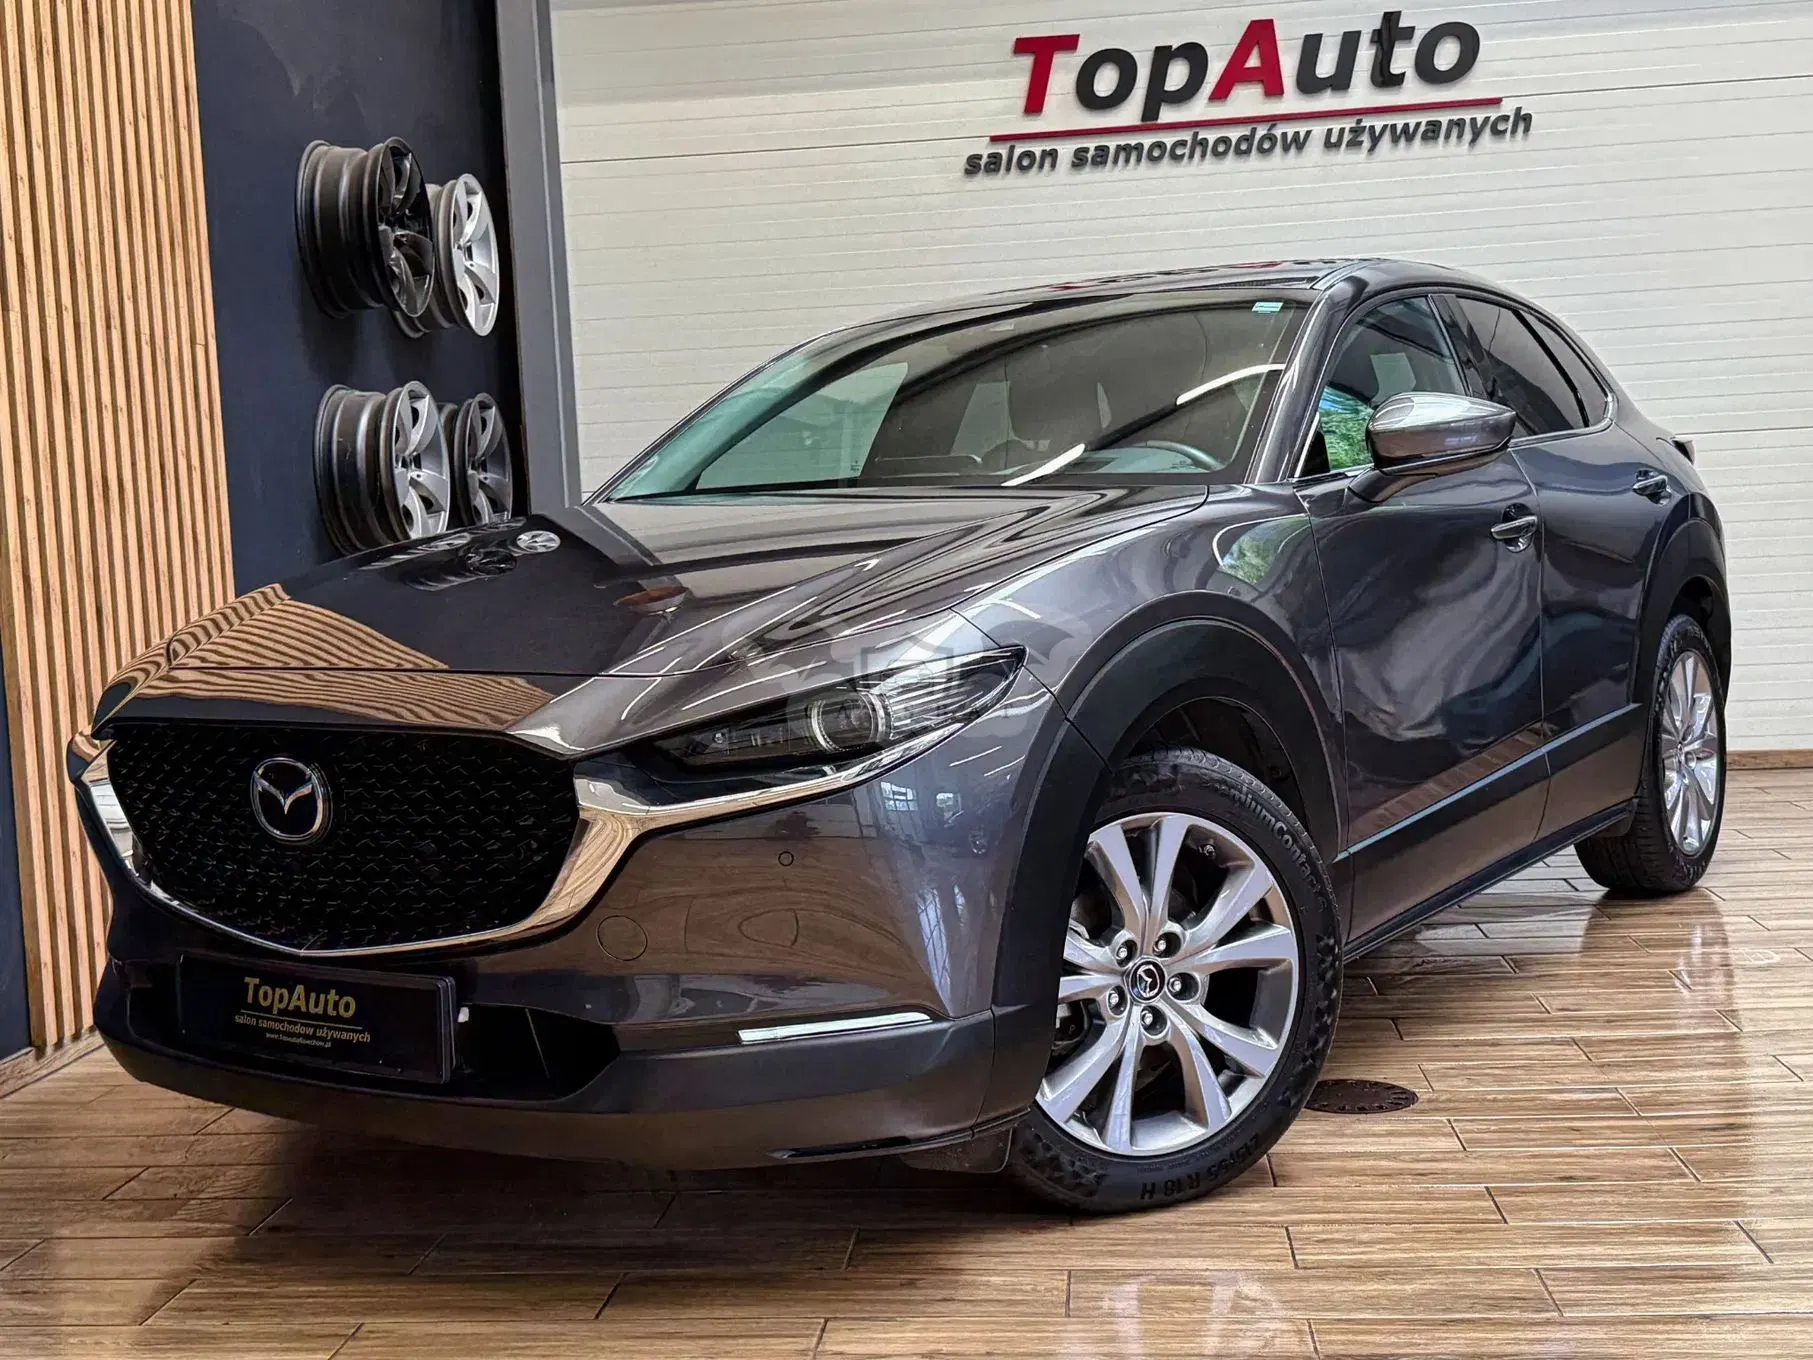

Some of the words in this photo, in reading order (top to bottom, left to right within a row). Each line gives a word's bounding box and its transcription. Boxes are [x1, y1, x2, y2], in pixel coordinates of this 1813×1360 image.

[1012, 11, 1481, 122] TopAuto
[964, 145, 1059, 175] salon
[1071, 123, 1313, 168] samochodów
[1324, 106, 1533, 153] używanych
[234, 1014, 257, 1026] salon
[244, 976, 357, 1019] TopAuto
